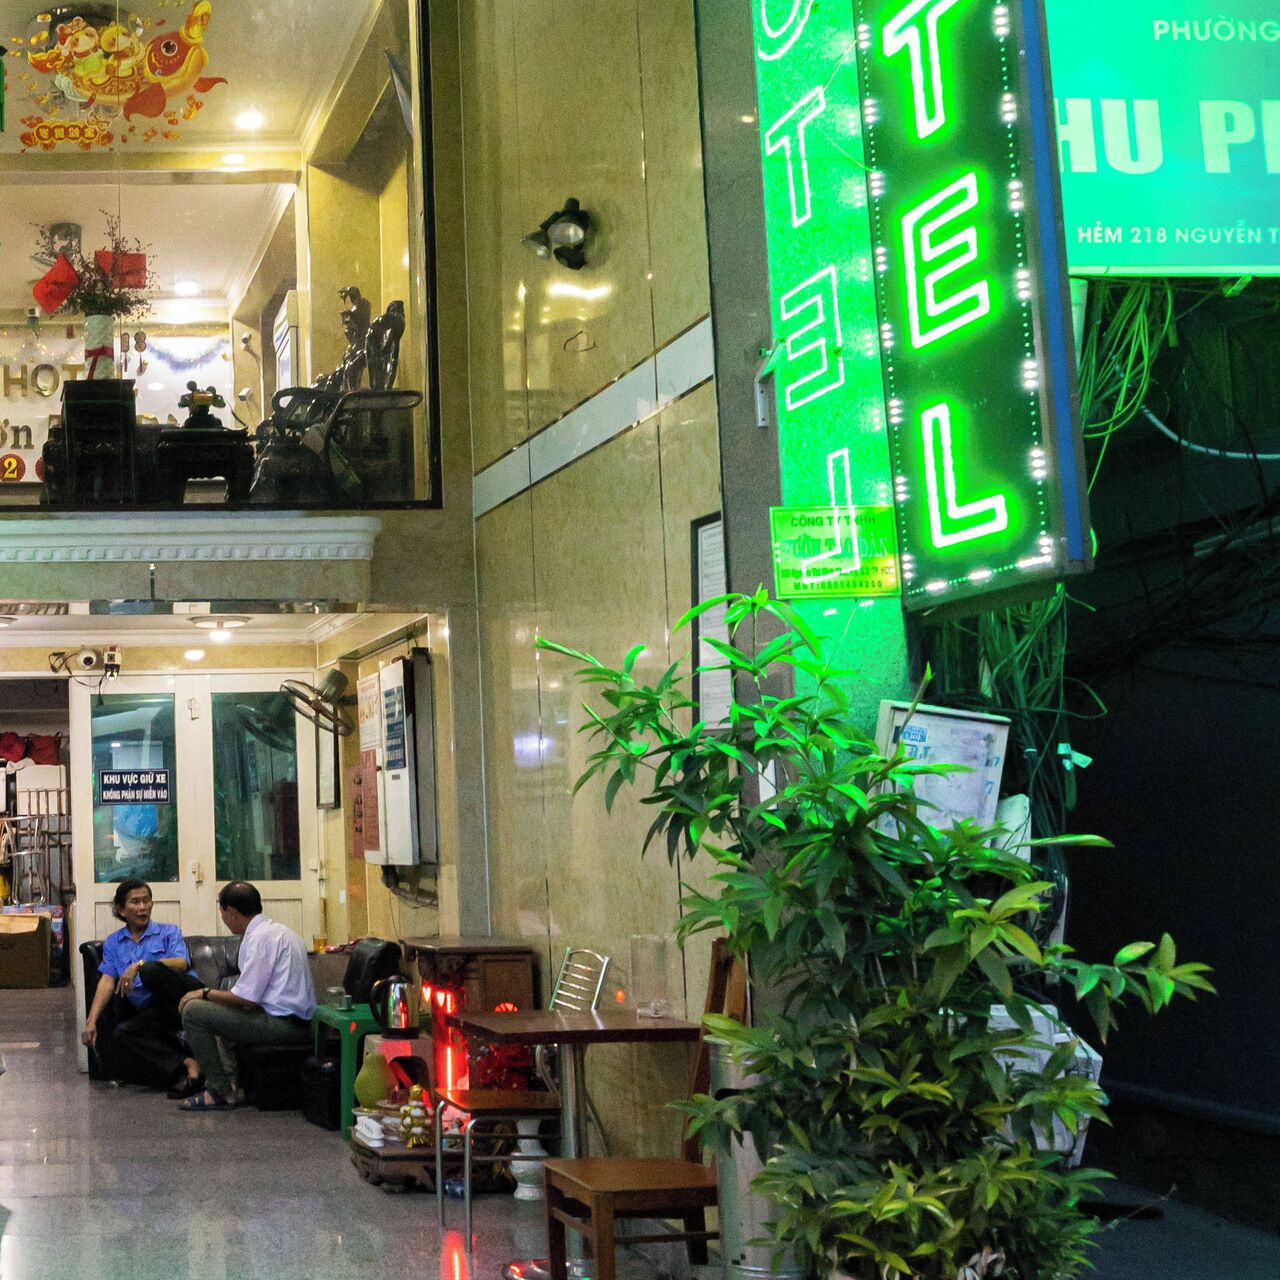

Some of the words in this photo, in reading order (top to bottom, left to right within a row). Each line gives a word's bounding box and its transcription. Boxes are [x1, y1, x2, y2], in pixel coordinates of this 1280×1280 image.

[1153, 14, 1280, 42] PHƯỜNG
[1077, 220, 1123, 244] HẺM
[1130, 226, 1168, 244] 218
[1175, 220, 1262, 244] NGUYỄN
[3, 457, 18, 479] 2
[103, 774, 121, 785] KHU
[122, 772, 139, 787] VỰC
[155, 773, 167, 784] XE
